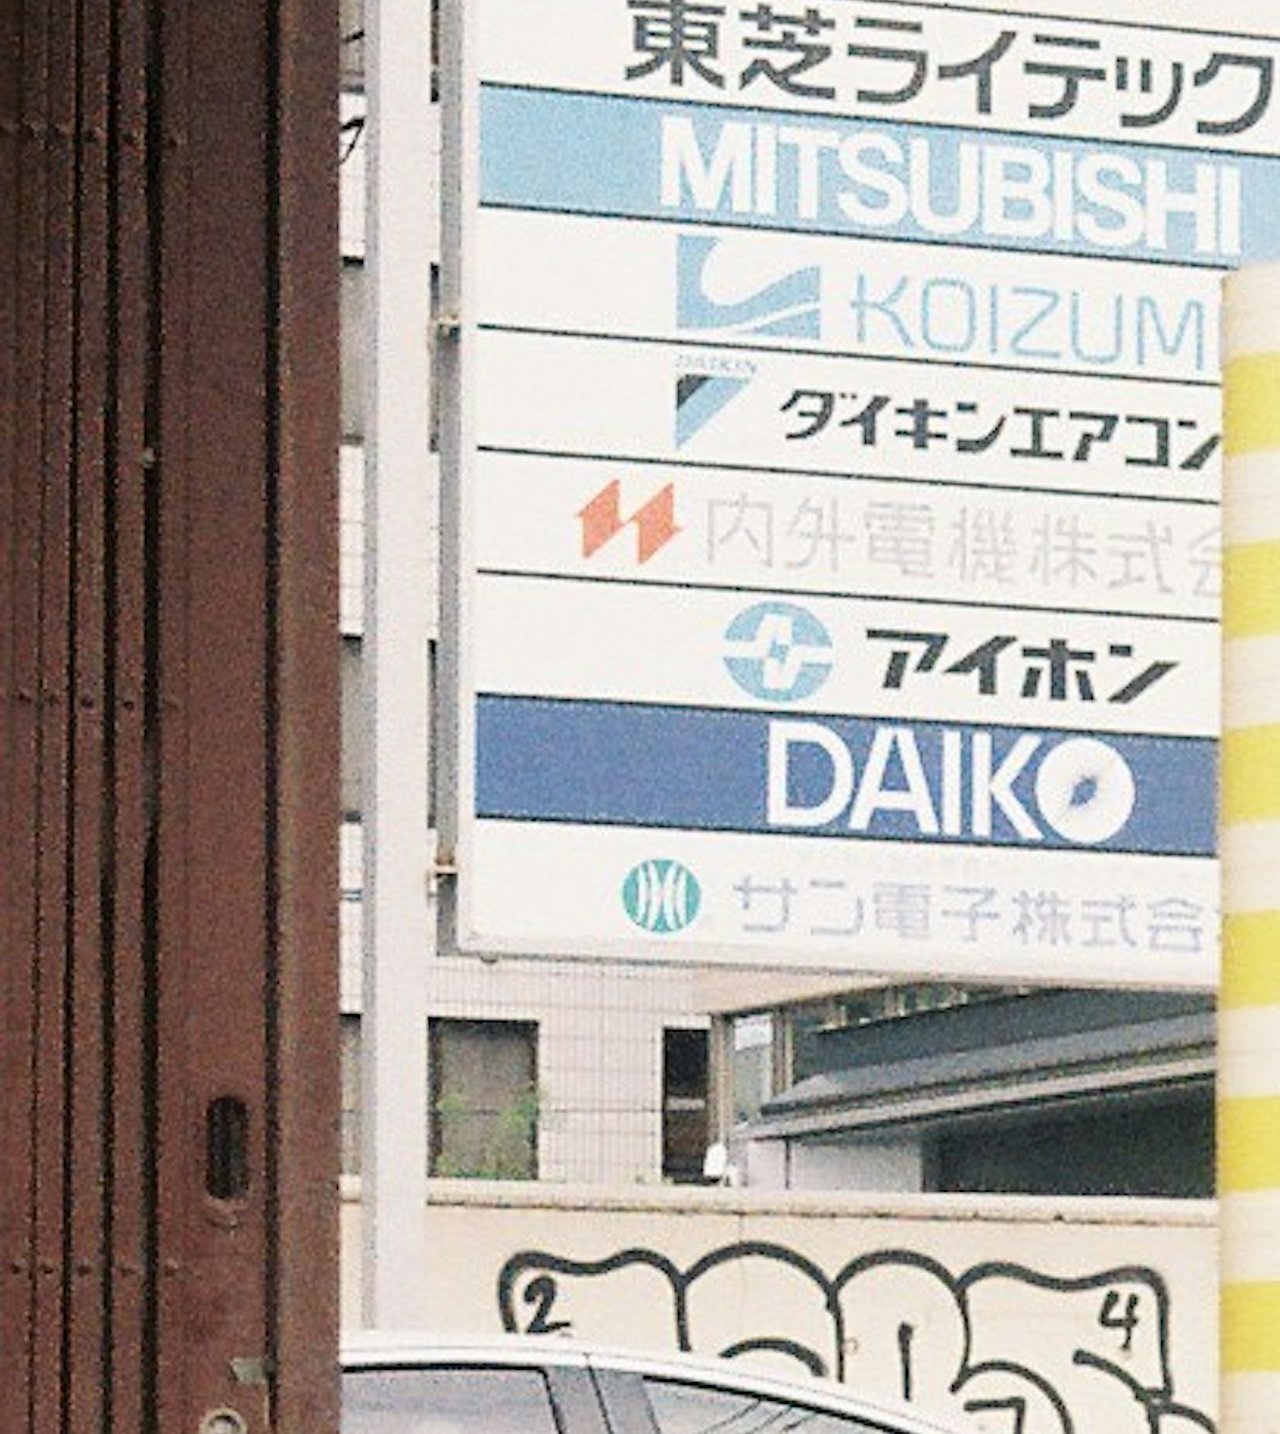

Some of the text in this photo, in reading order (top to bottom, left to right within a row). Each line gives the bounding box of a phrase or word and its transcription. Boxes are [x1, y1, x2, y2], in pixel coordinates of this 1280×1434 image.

[659, 115, 1241, 257] MITSUBISHI
[851, 269, 1203, 370] KOIZUM
[780, 389, 1221, 470] ダイキンエアコン
[867, 627, 1179, 704] アイホン
[767, 722, 1135, 843] DAIKO
[733, 874, 1220, 954] サン電子株式会
